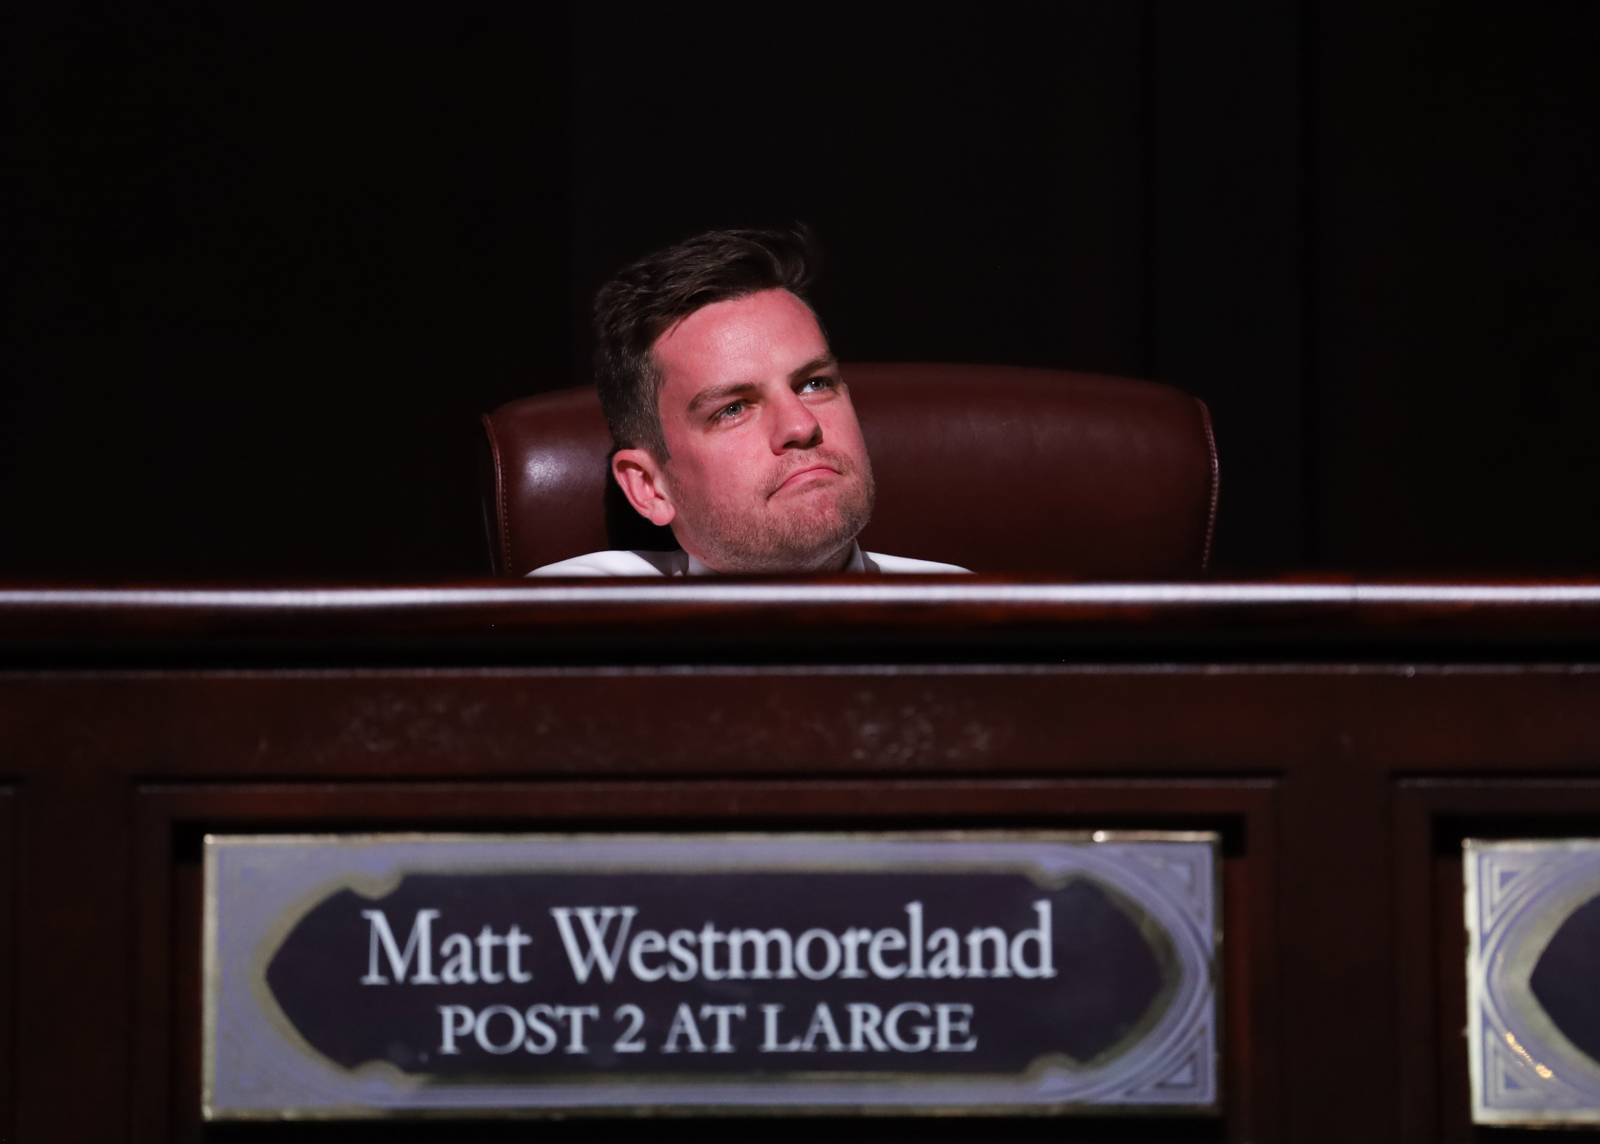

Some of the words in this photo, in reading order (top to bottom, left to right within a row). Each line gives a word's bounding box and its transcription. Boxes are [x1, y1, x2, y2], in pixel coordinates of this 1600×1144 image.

[361, 906, 532, 986] Matt
[550, 899, 1056, 983] Westmoreland
[438, 1003, 599, 1055] POST
[612, 1003, 646, 1053] 2
[662, 1003, 747, 1053] AT
[762, 1002, 978, 1053] LARGE
